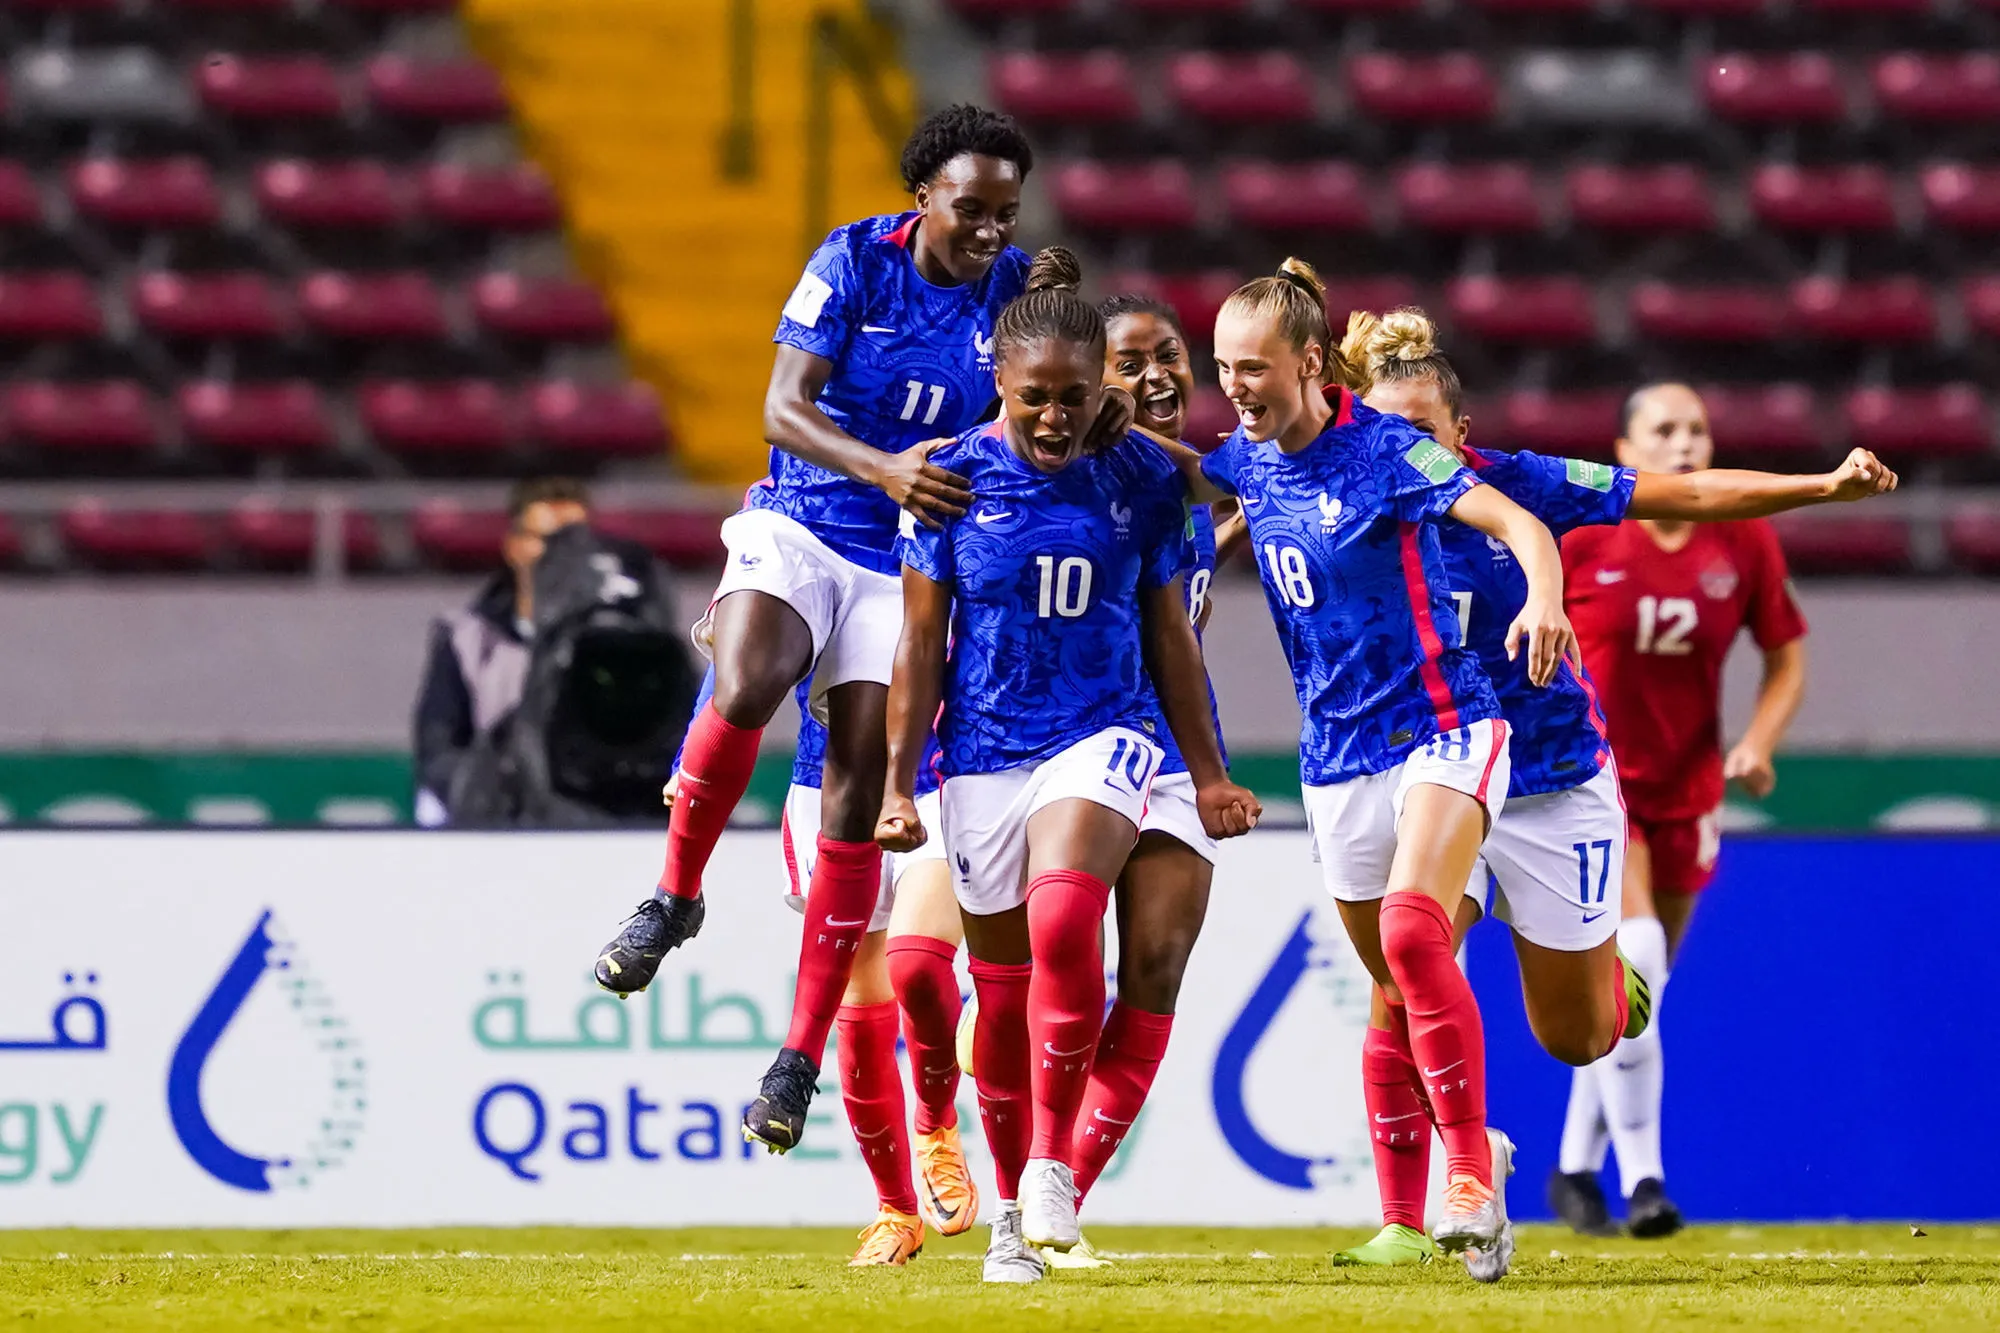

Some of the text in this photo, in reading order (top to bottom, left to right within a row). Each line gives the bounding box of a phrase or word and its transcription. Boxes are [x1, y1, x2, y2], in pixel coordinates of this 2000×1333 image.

[900, 379, 946, 425] 11
[1036, 555, 1093, 619] 10
[1264, 543, 1315, 608] 18
[1450, 591, 1473, 647] 7
[1635, 595, 1699, 655] 12
[1107, 737, 1153, 792] 10
[1573, 839, 1613, 904] 17
